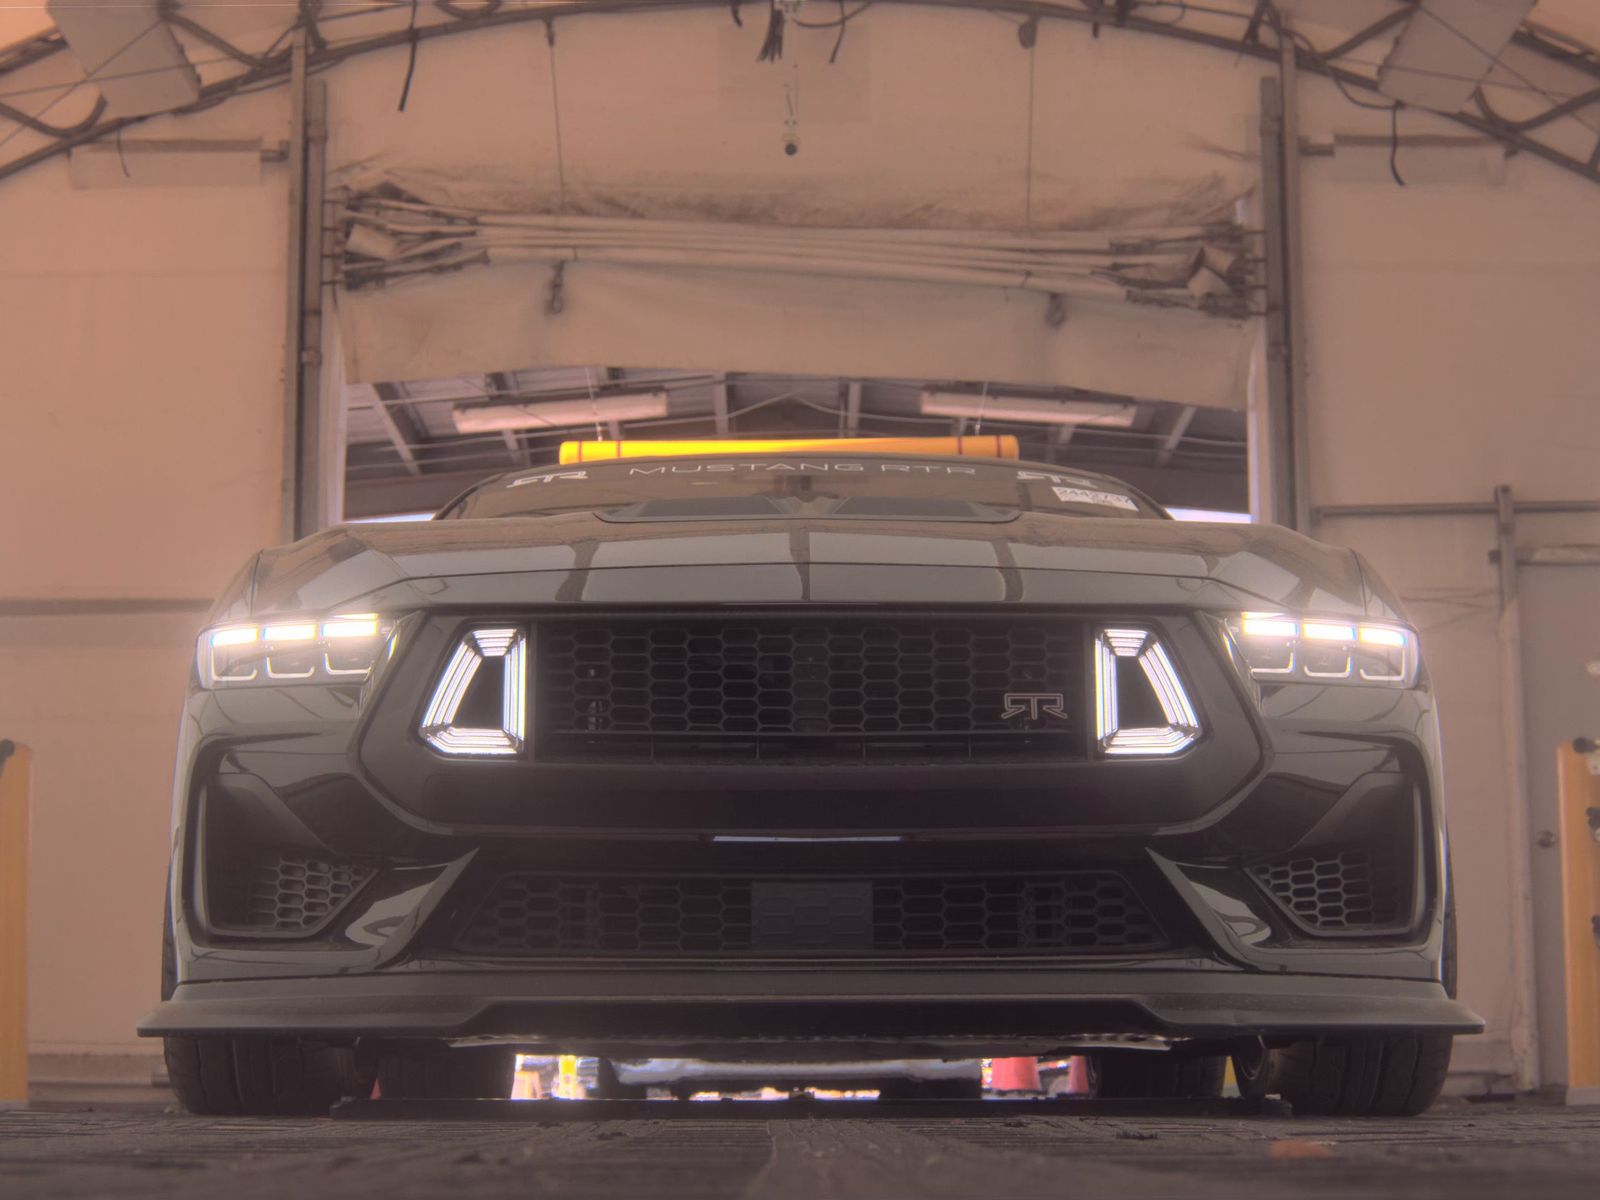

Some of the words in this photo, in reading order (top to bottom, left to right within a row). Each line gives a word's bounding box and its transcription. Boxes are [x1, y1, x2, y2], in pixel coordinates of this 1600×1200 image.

[629, 462, 865, 476] MUSTANG
[881, 463, 976, 476] RTR
[1001, 693, 1068, 720] RTR
